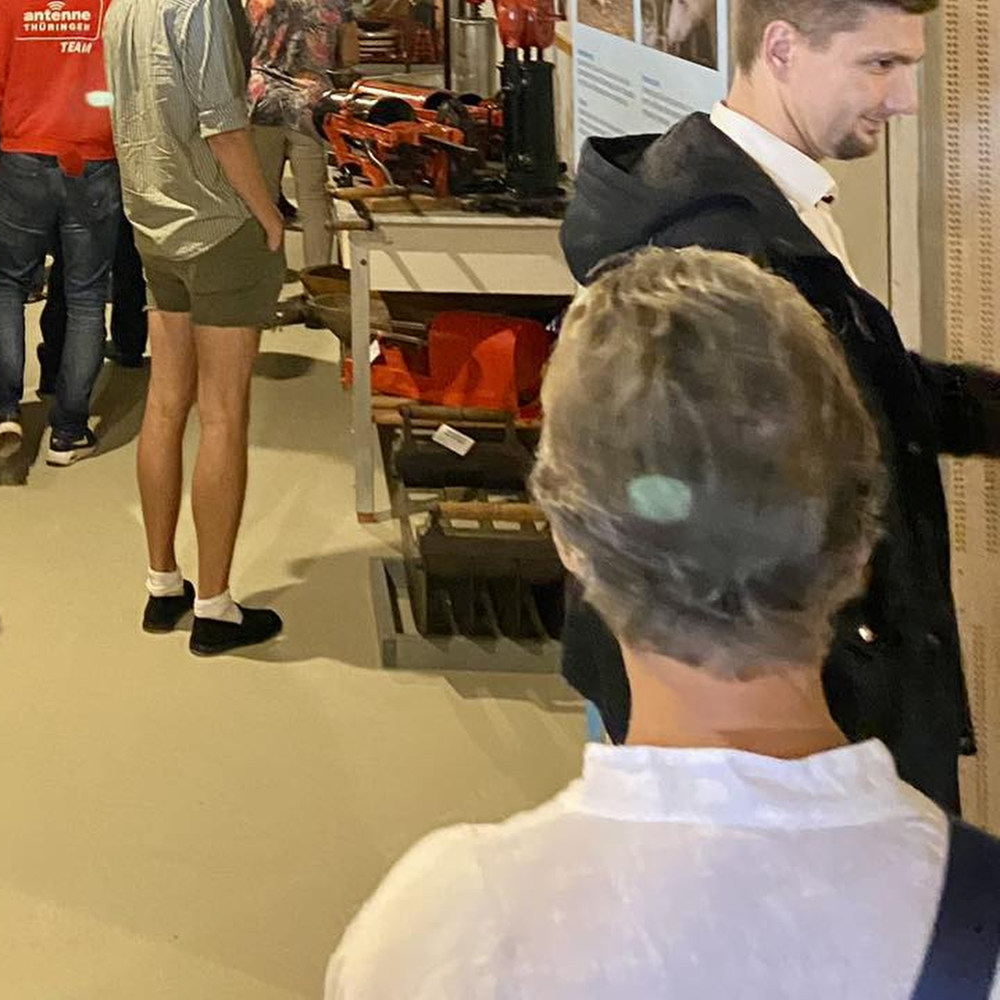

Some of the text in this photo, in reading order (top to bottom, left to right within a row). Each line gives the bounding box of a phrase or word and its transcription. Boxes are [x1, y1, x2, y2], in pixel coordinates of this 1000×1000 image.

[23, 9, 91, 21] antenne
[23, 22, 90, 31] THÜRINGEN
[60, 41, 93, 54] TEAM
